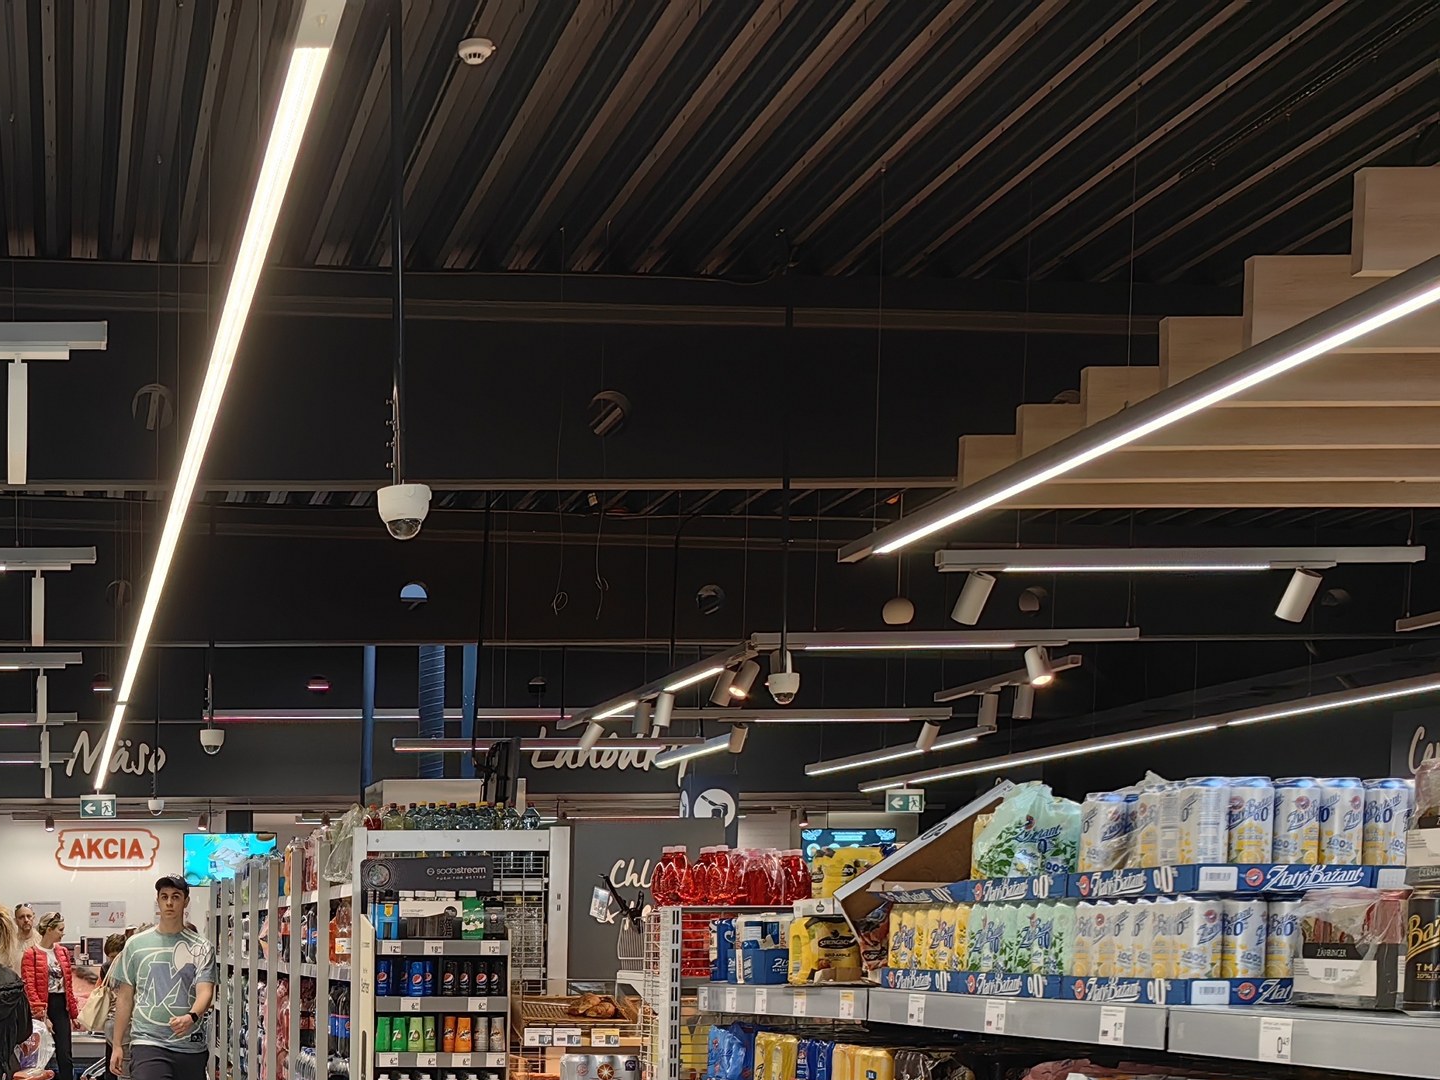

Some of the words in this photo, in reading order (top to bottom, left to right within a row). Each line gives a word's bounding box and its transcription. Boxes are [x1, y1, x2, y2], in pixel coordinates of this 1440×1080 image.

[68, 837, 145, 860] AKCIA
[1262, 864, 1310, 891] Zlatý
[1308, 862, 1365, 888] Bažant
